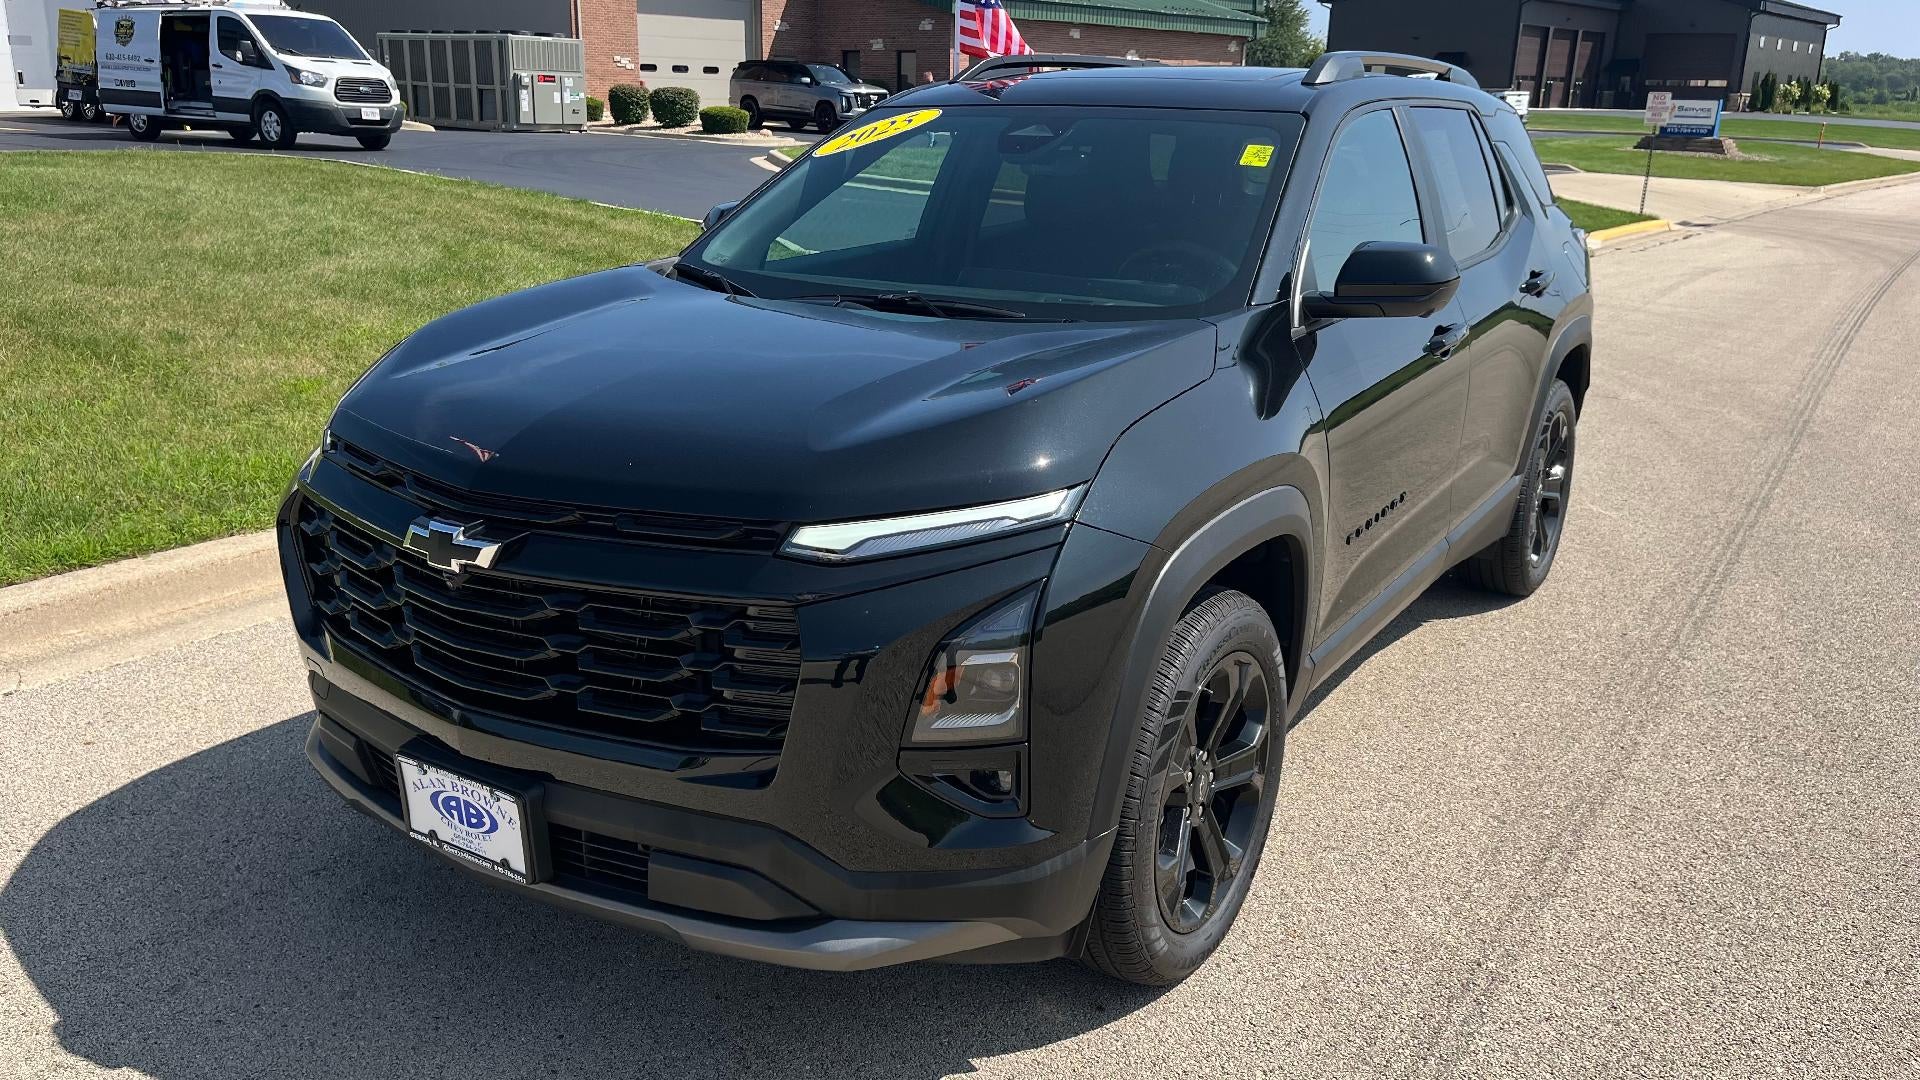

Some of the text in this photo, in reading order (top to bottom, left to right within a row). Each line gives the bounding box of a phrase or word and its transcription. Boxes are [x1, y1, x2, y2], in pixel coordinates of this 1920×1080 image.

[835, 112, 920, 150] 2025
[411, 777, 518, 831] ALAN BROWNE
[440, 795, 487, 830] AB
[440, 816, 493, 842] CHEVROLET
